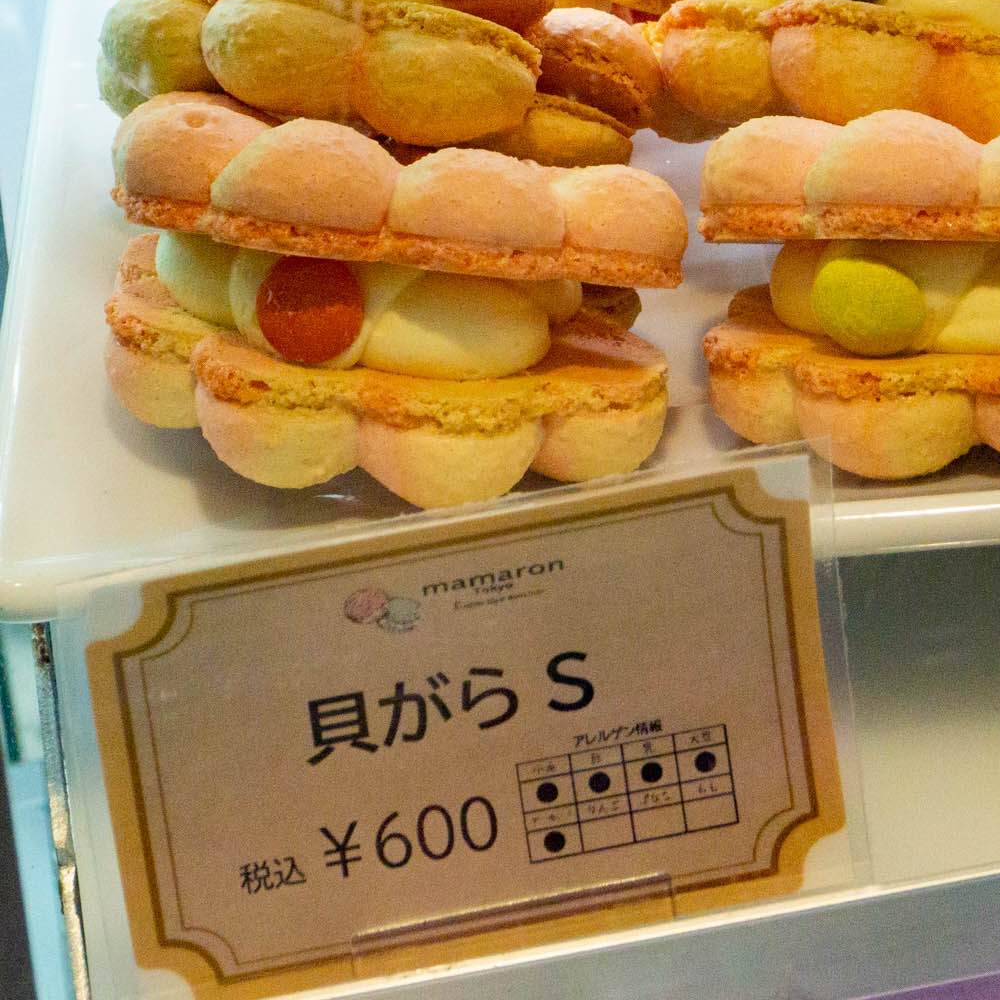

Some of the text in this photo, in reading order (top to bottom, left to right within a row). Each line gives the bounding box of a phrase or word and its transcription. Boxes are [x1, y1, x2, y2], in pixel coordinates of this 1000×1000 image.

[421, 559, 565, 597] mamaron
[306, 650, 595, 766] 貝がら S
[239, 795, 499, 898] 税込 ¥600
